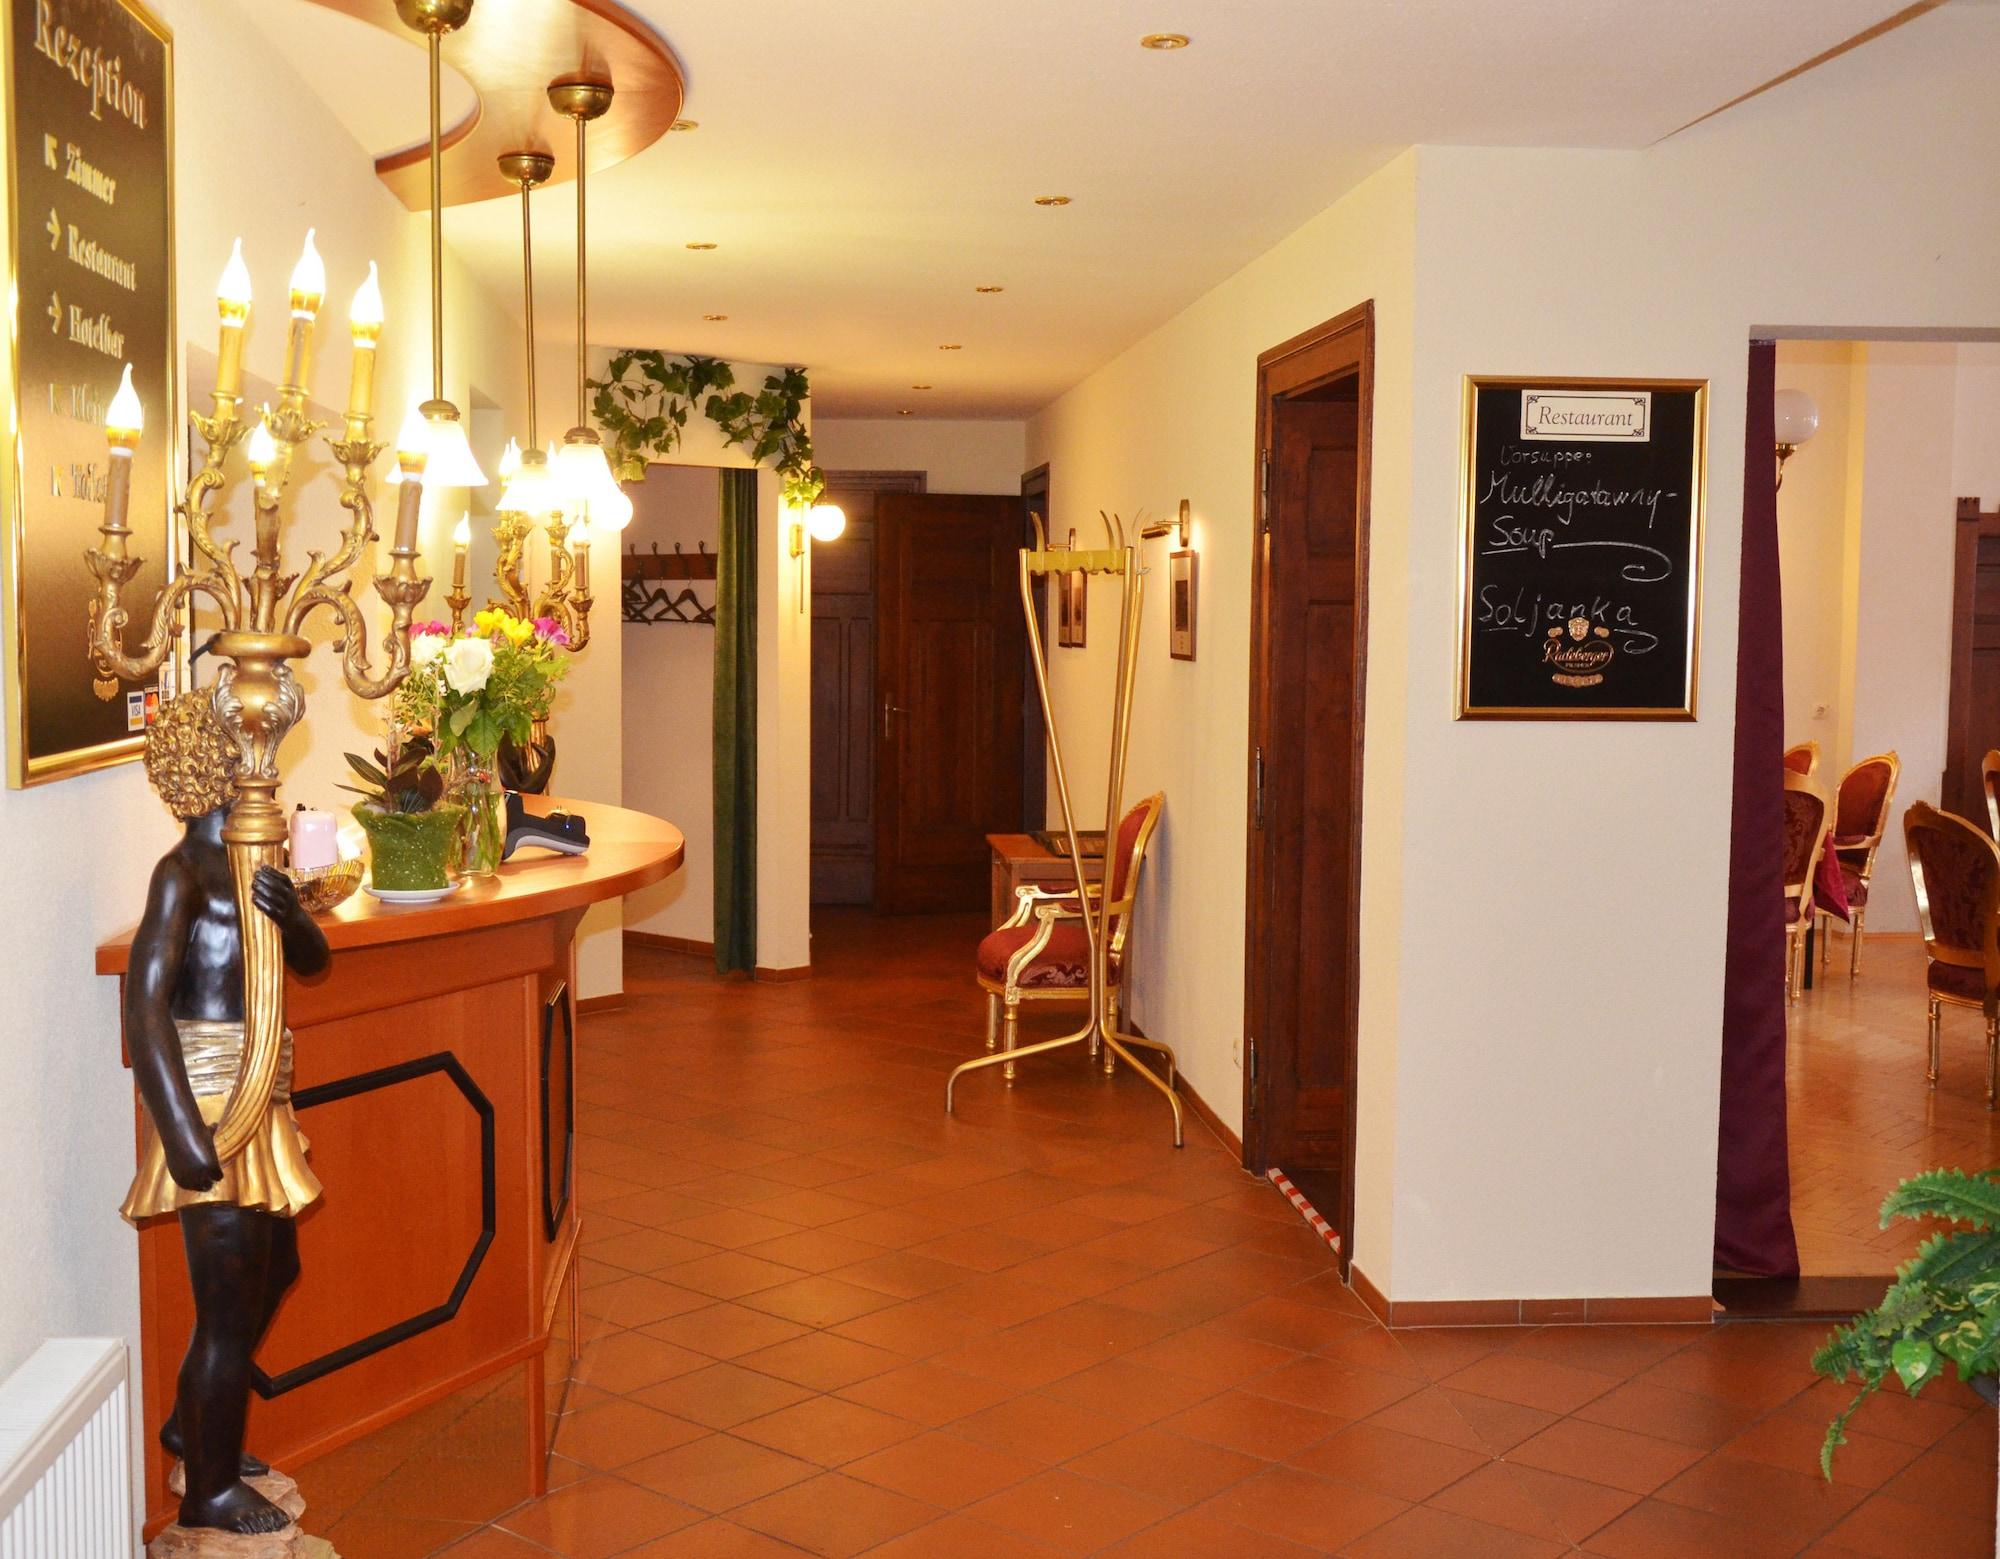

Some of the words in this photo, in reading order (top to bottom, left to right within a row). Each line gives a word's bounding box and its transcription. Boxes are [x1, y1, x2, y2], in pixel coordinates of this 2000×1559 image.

[34, 0, 148, 129] Rezeption
[65, 142, 117, 205] Zimmer
[67, 223, 137, 291] Restaurant
[1538, 406, 1634, 426] Restaurant
[1489, 515, 1555, 559] Soup
[1478, 584, 1638, 637] Soljanka
[1542, 639, 1611, 667] Radeberger
